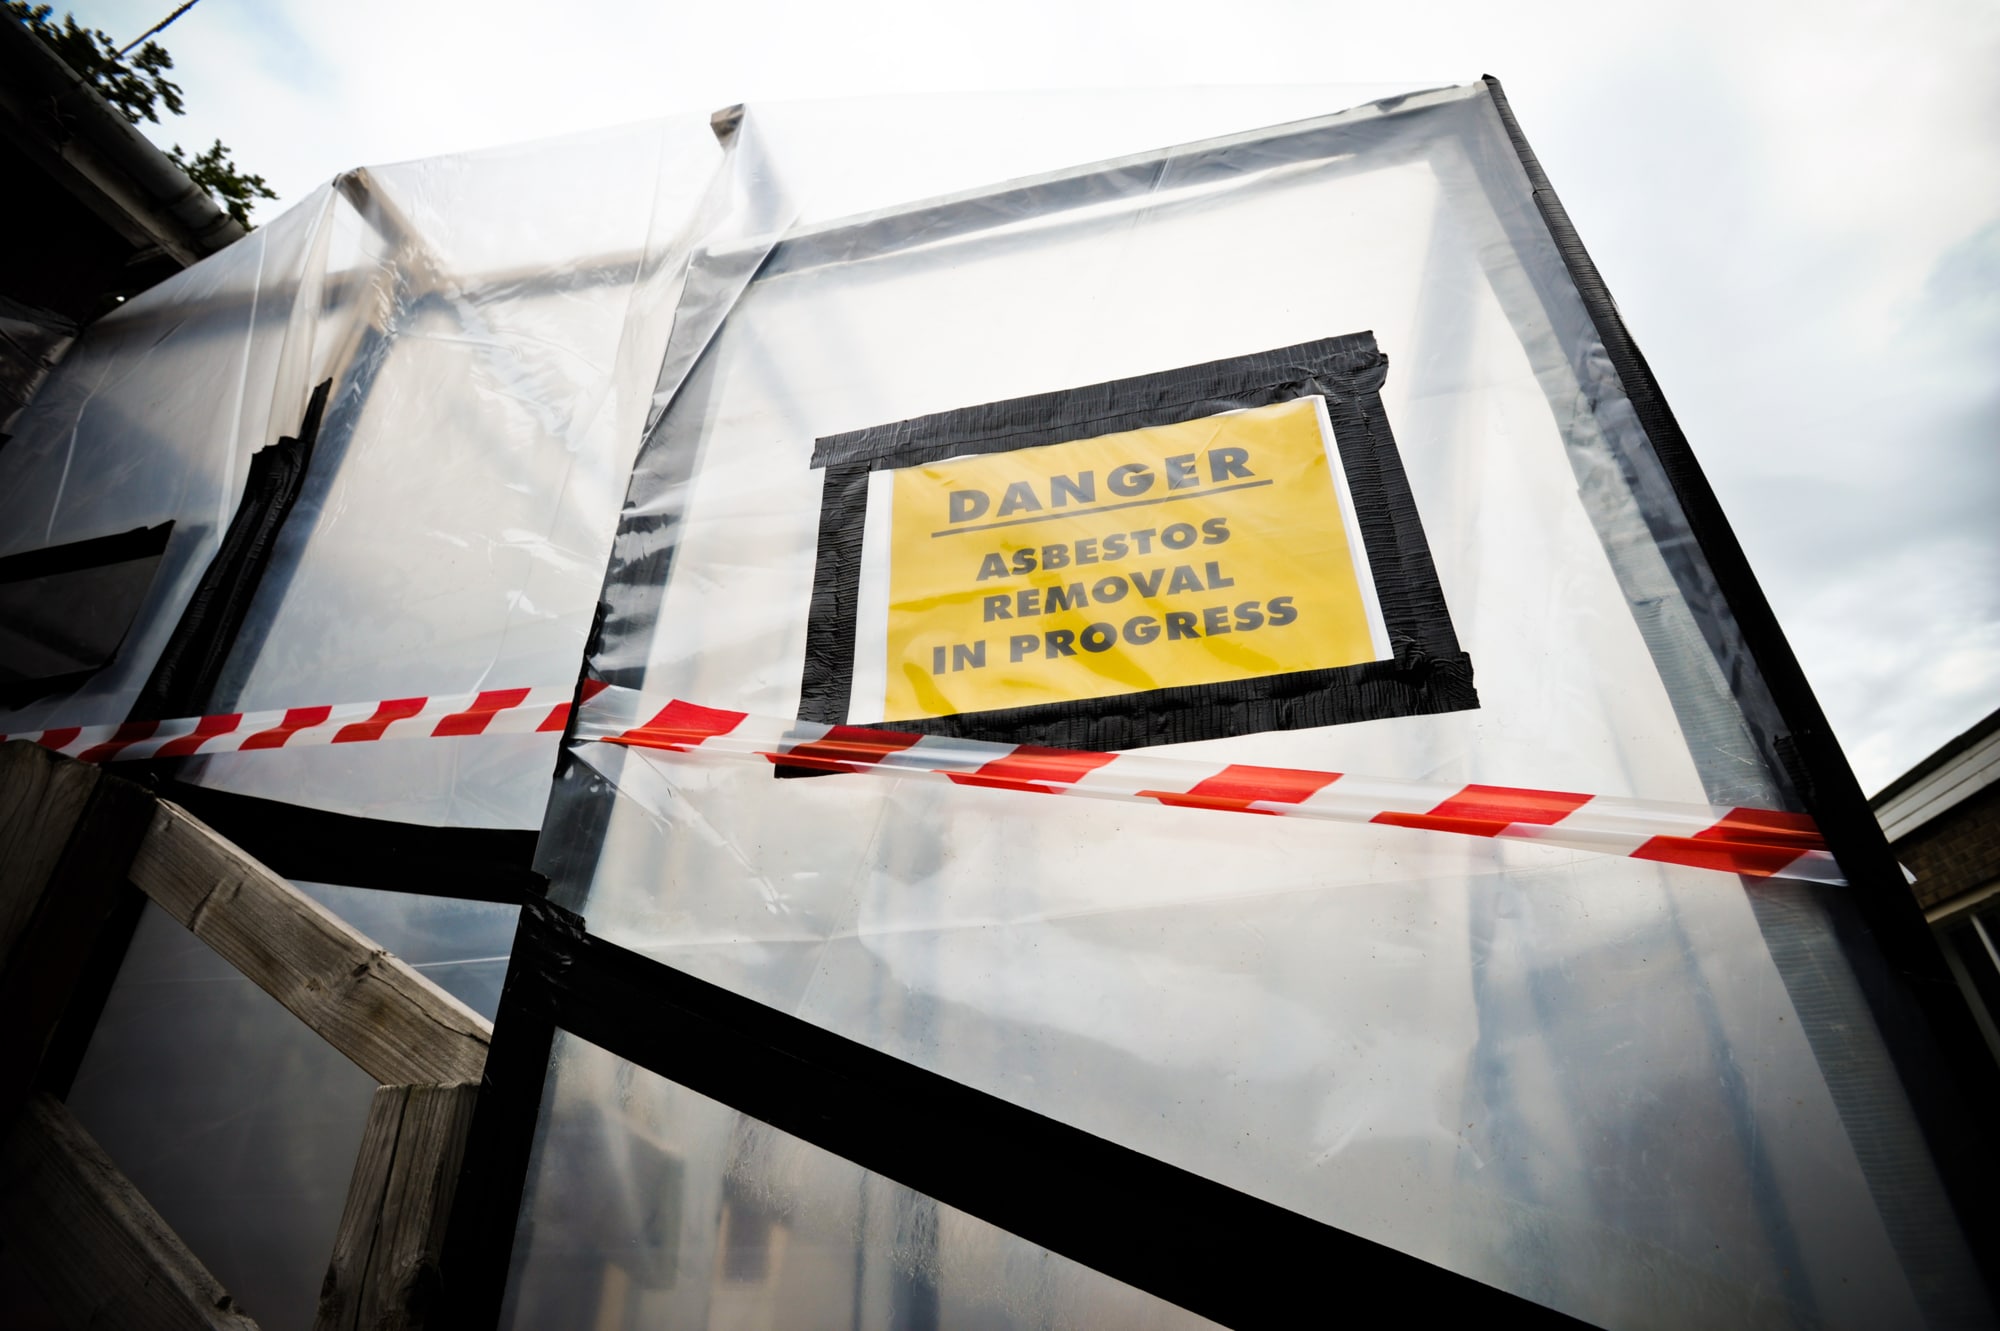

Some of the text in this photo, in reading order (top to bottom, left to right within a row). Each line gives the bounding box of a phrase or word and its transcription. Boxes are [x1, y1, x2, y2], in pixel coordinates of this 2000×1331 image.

[948, 447, 1256, 524] DANGER
[976, 517, 1232, 582] ASBESTOS
[983, 561, 1235, 623] REMOVAL
[932, 596, 1299, 676] IN PROGRESS
